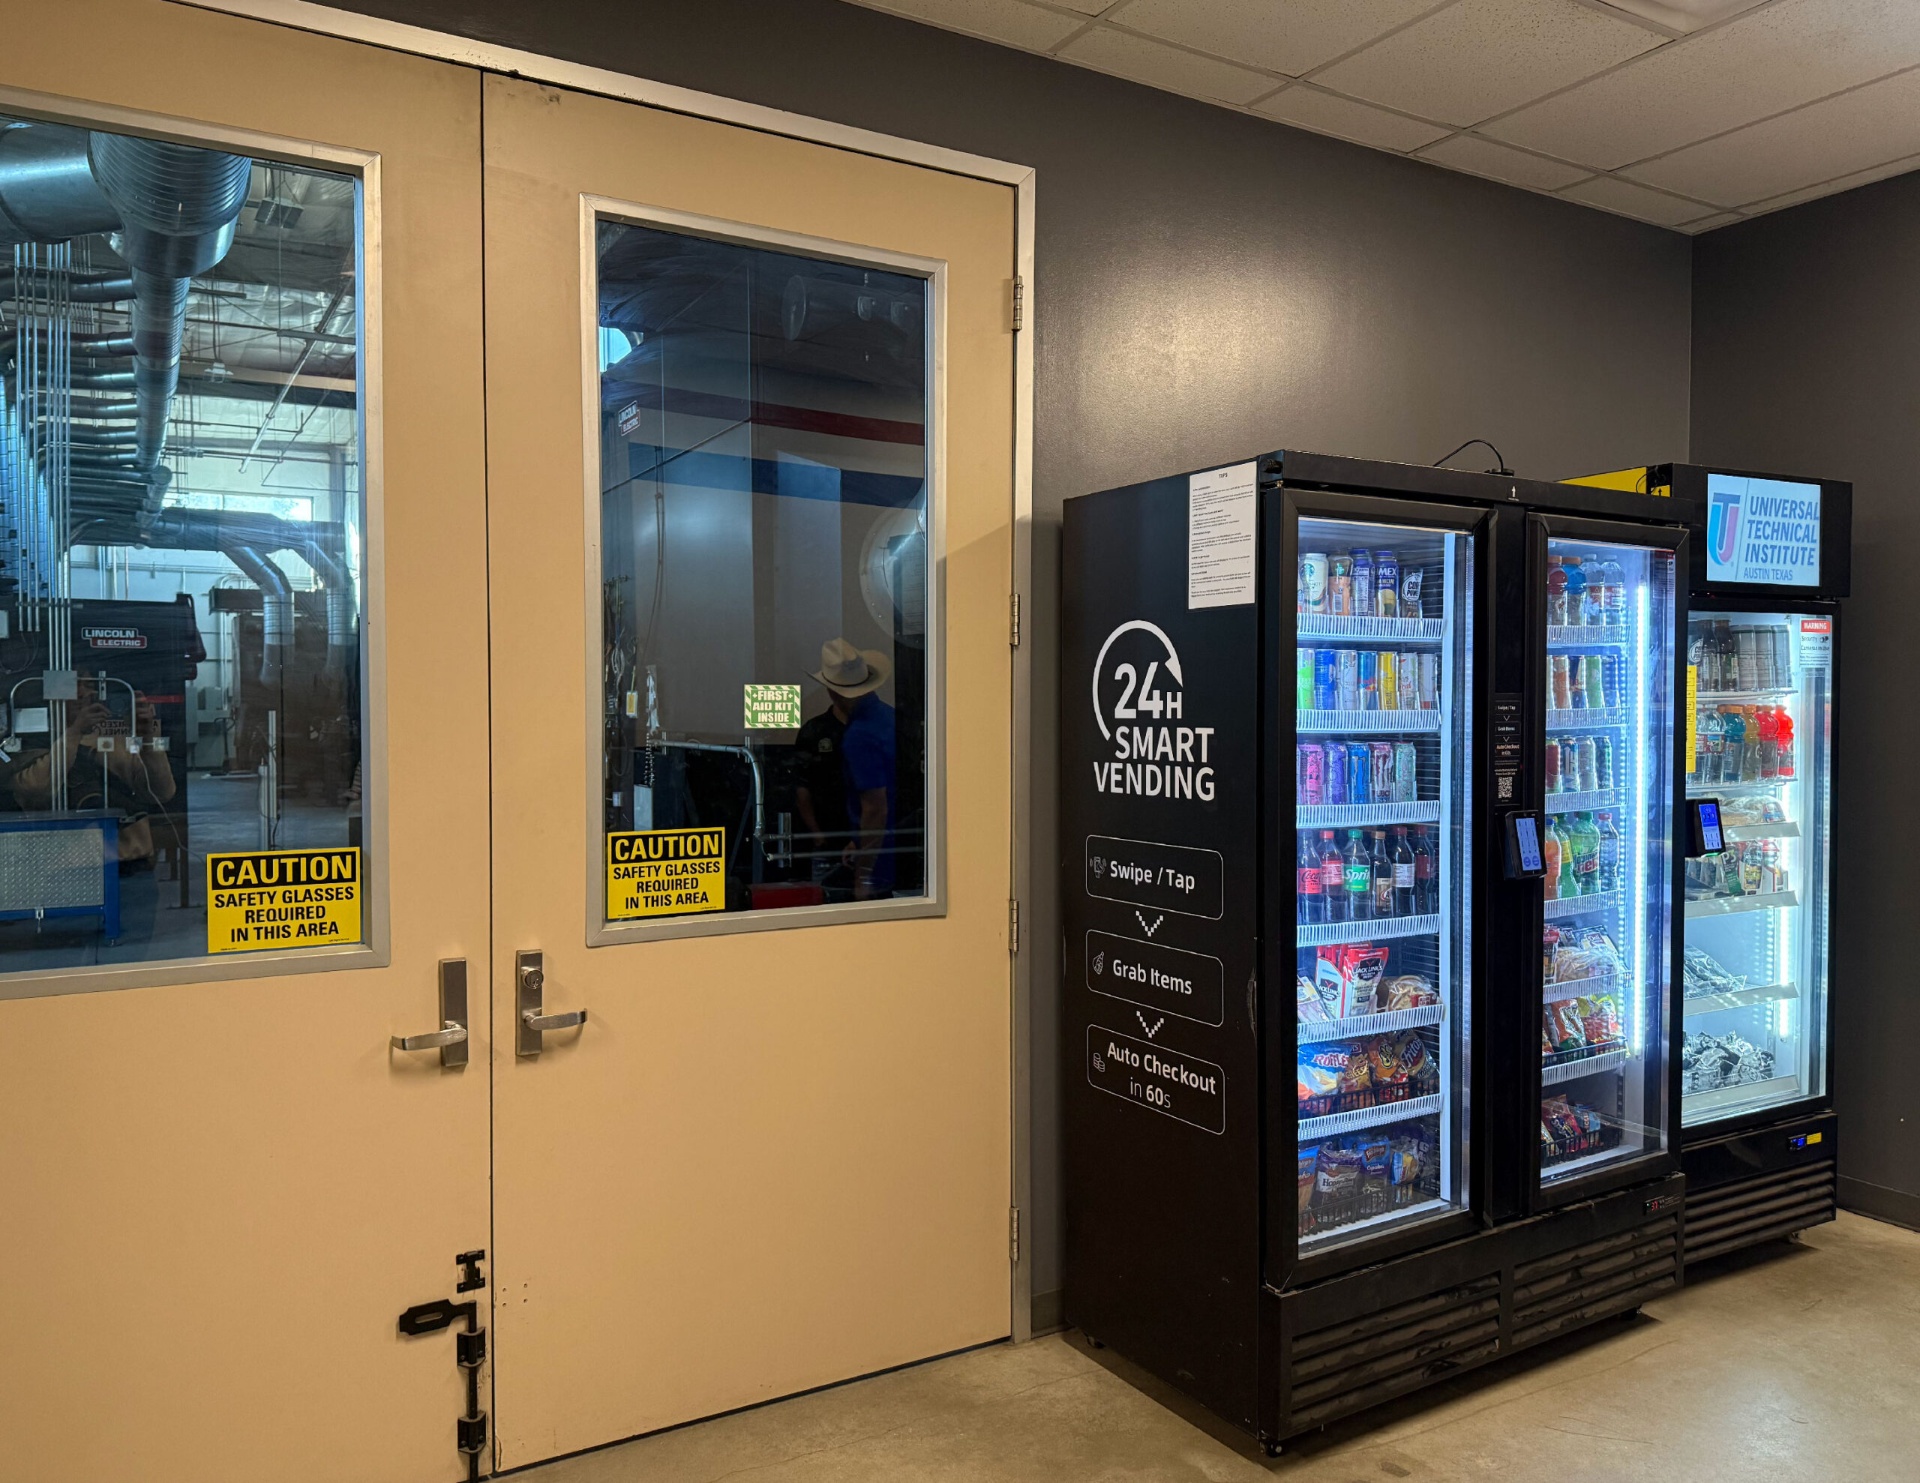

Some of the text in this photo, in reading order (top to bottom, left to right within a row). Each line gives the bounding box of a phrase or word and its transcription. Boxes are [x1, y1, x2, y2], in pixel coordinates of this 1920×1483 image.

[1749, 495, 1820, 520] UNIVERSAL
[1747, 519, 1817, 543] TECHNICAL
[1744, 543, 1816, 566] INSTITUTE
[1743, 567, 1793, 581] AUSTIN TEXAS
[84, 629, 136, 638] LINCOLN
[757, 690, 790, 701] FIRST
[1114, 661, 1183, 719] 24H
[752, 702, 794, 711] AID KIT
[757, 712, 790, 723] INSIDE
[1114, 725, 1215, 763] SMART
[1093, 761, 1215, 801] VENDING
[616, 834, 719, 861] CAUTION
[216, 854, 352, 886] CAUTION
[613, 861, 721, 880] SAFETY GLASSES
[1110, 860, 1153, 886] Swipe
[1165, 869, 1195, 894] Tap
[214, 886, 354, 908] SAFETY GLASSES
[636, 877, 699, 894] REQUIRED
[625, 891, 709, 910] IN THIS AREA
[245, 905, 326, 924] REQUIRED
[231, 921, 339, 943] IN THIS AREA
[1112, 959, 1192, 995] Grab Items
[1107, 1042, 1216, 1095] Auto Checkout
[1130, 1076, 1171, 1108] in 60s
